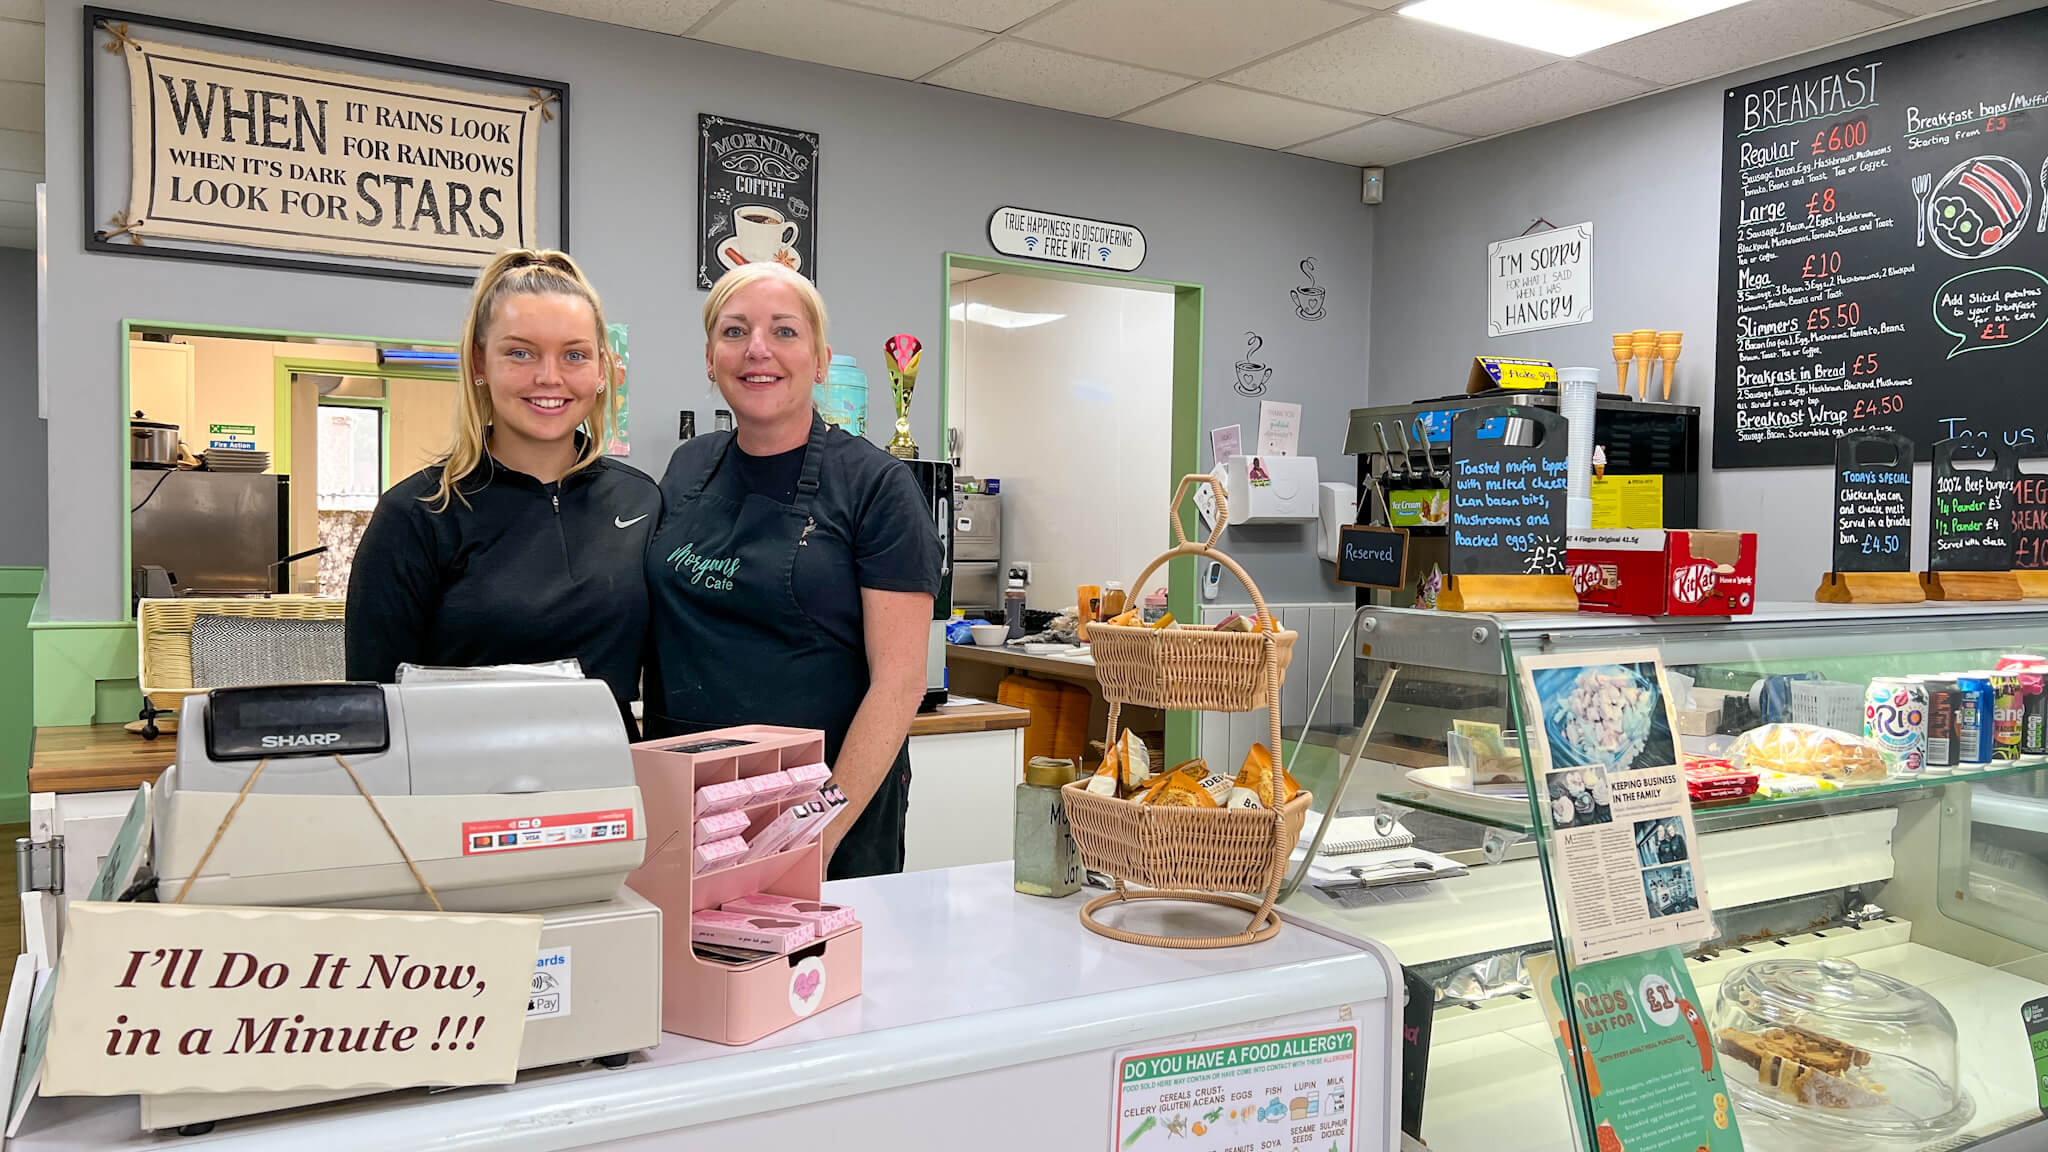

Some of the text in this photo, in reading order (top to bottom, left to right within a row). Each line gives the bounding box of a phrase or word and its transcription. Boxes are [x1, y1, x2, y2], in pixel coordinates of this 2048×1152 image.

[1744, 62, 1882, 131] BREAKFAST
[159, 73, 511, 155] WHEN IT RAINS LOOK
[1907, 106, 1973, 133] Breakfast
[1741, 120, 1867, 168] Regular £6.00
[1908, 117, 2007, 150] Starting from £3
[343, 136, 514, 177] FOR RAINBOWS
[712, 133, 810, 172] MORNING
[169, 148, 347, 186] WHEN IT'S DARK
[736, 175, 785, 199] COFFEE
[170, 171, 505, 240] LOOK FOR STARS
[1740, 187, 1836, 224] Large £8
[1005, 213, 1133, 247] TRUE HAPPINESS IS DISCOVERING
[1044, 238, 1091, 261] FREE WIFI
[1499, 241, 1581, 277] I'M SORRY
[1506, 279, 1520, 289] FOR
[1522, 275, 1539, 287] WHAT
[1553, 269, 1573, 281] SAID
[1739, 251, 1842, 289] Mega £10
[1547, 283, 1562, 295] WAS
[1941, 291, 2000, 307] Add Sliced
[1506, 294, 1573, 326] HANGRY
[1737, 301, 1860, 338] Slimmers £5.50
[1953, 306, 1964, 316] to
[1967, 305, 1991, 321] your
[1973, 315, 1989, 327] for
[1980, 323, 2009, 339] £1
[1737, 353, 1878, 387] Breakfast in Bread £5
[1737, 395, 1904, 428] Breakfast Wrap £4.50
[1455, 459, 1500, 475] Toasted
[1879, 472, 1911, 484] SPECIAL
[1457, 479, 1481, 490] with
[1486, 477, 1526, 491] melted
[1937, 476, 2014, 499] 100% Beef burgers
[1455, 494, 1484, 507] Lean
[1485, 493, 1519, 507] bacon
[1839, 504, 1855, 514] and
[1885, 504, 1905, 514] melt
[1937, 497, 1950, 516] 1/4
[1454, 513, 1550, 526] Mushrooms and
[1868, 517, 1876, 527] in
[1878, 519, 1884, 527] a
[1936, 519, 1949, 536] 1/2
[1985, 518, 1999, 531] £4
[1455, 530, 1498, 547] Poached
[1598, 536, 1621, 544] Original
[1622, 536, 1640, 545] 41.5g
[1861, 533, 1899, 554] £4.50
[667, 543, 740, 584] Morgans
[1345, 543, 1394, 562] Reserved
[1532, 546, 1557, 569] £5
[705, 576, 734, 591] Cafe
[1676, 565, 1713, 603] KitKat
[261, 733, 341, 748] SHARP
[1611, 775, 1677, 791] KEEPING BUSINESS
[1613, 789, 1661, 803] IN THE FAMILY
[1064, 860, 1079, 885] Jar
[536, 954, 565, 967] ards
[114, 948, 487, 997] I'll Do It Now,
[537, 998, 557, 1011] Pay
[1577, 990, 1628, 1019] KIDS
[1586, 1013, 1635, 1035] EAT FOR
[105, 1014, 486, 1057] in a Minute !!!
[1125, 1033, 1353, 1080] DO YOU HAVE A FOOD ALLERGY?
[1160, 1077, 1344, 1103] CEREALS CRUST- EGGS FISH LUPIN MILK
[1124, 1095, 1225, 1117] CELERY (GLUTEN) ACEANS
[1290, 1119, 1348, 1135] SESAME SULPHUR
[1261, 1128, 1345, 1150] SOYA SEEDS DIOXIDE
